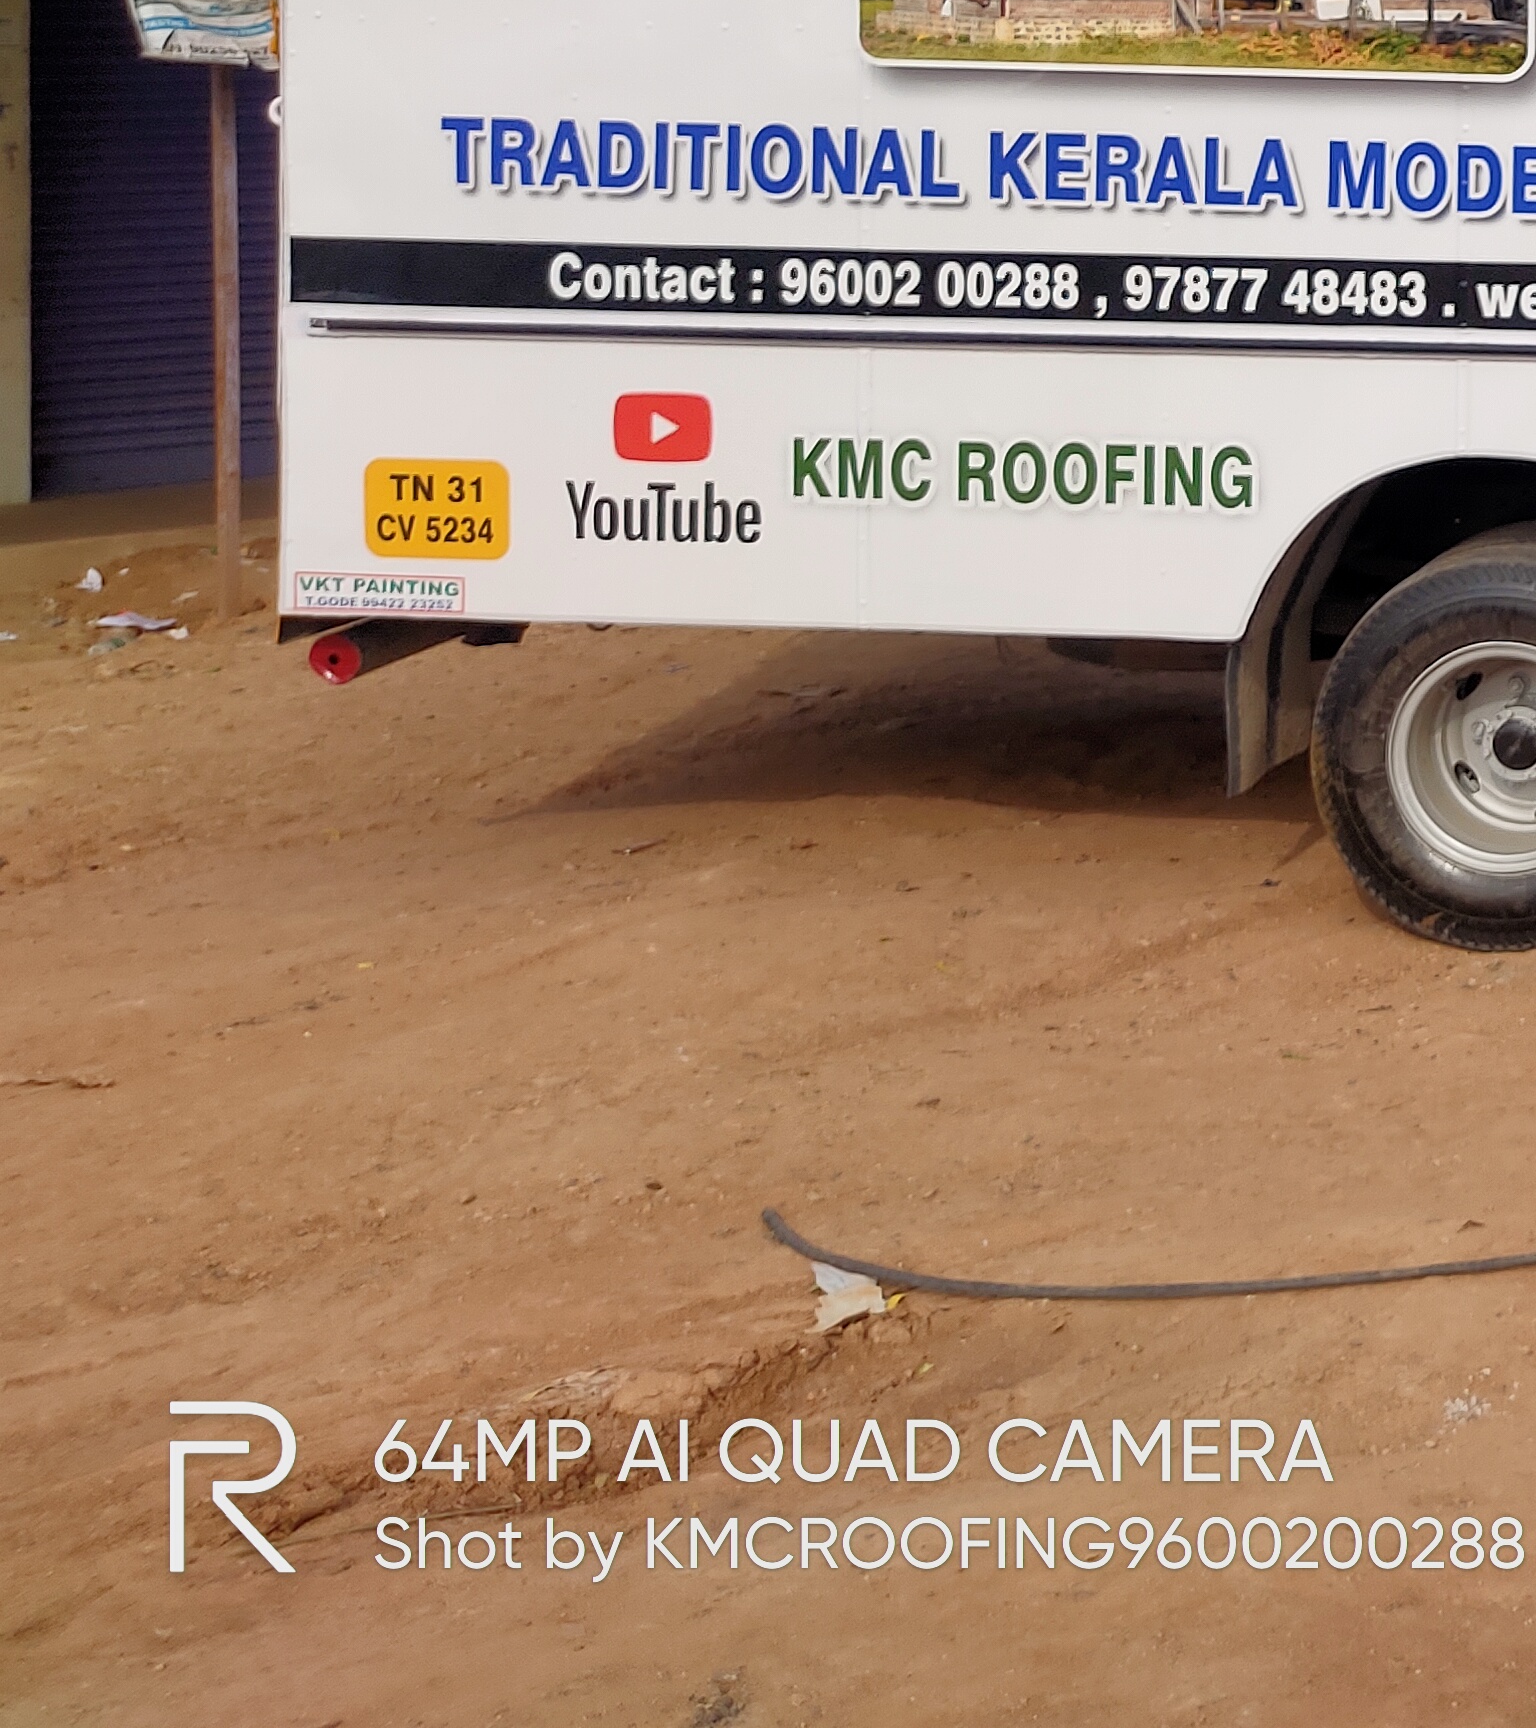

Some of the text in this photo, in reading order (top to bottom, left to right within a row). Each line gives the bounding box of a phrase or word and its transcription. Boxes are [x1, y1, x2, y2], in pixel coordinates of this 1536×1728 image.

[441, 117, 959, 200] TRADITIONAL
[989, 131, 1297, 209] KERALA
[549, 251, 735, 303] Contact
[781, 258, 921, 306] 96002
[937, 261, 1079, 309] 00288
[1125, 264, 1268, 313] 97877
[1283, 269, 1427, 318] 48483
[390, 473, 482, 503] TN 31
[792, 437, 1253, 508] KMC ROOFING
[376, 514, 494, 544] CV 5234
[566, 480, 762, 544] YouTube
[300, 576, 459, 597] VKT PAINTING
